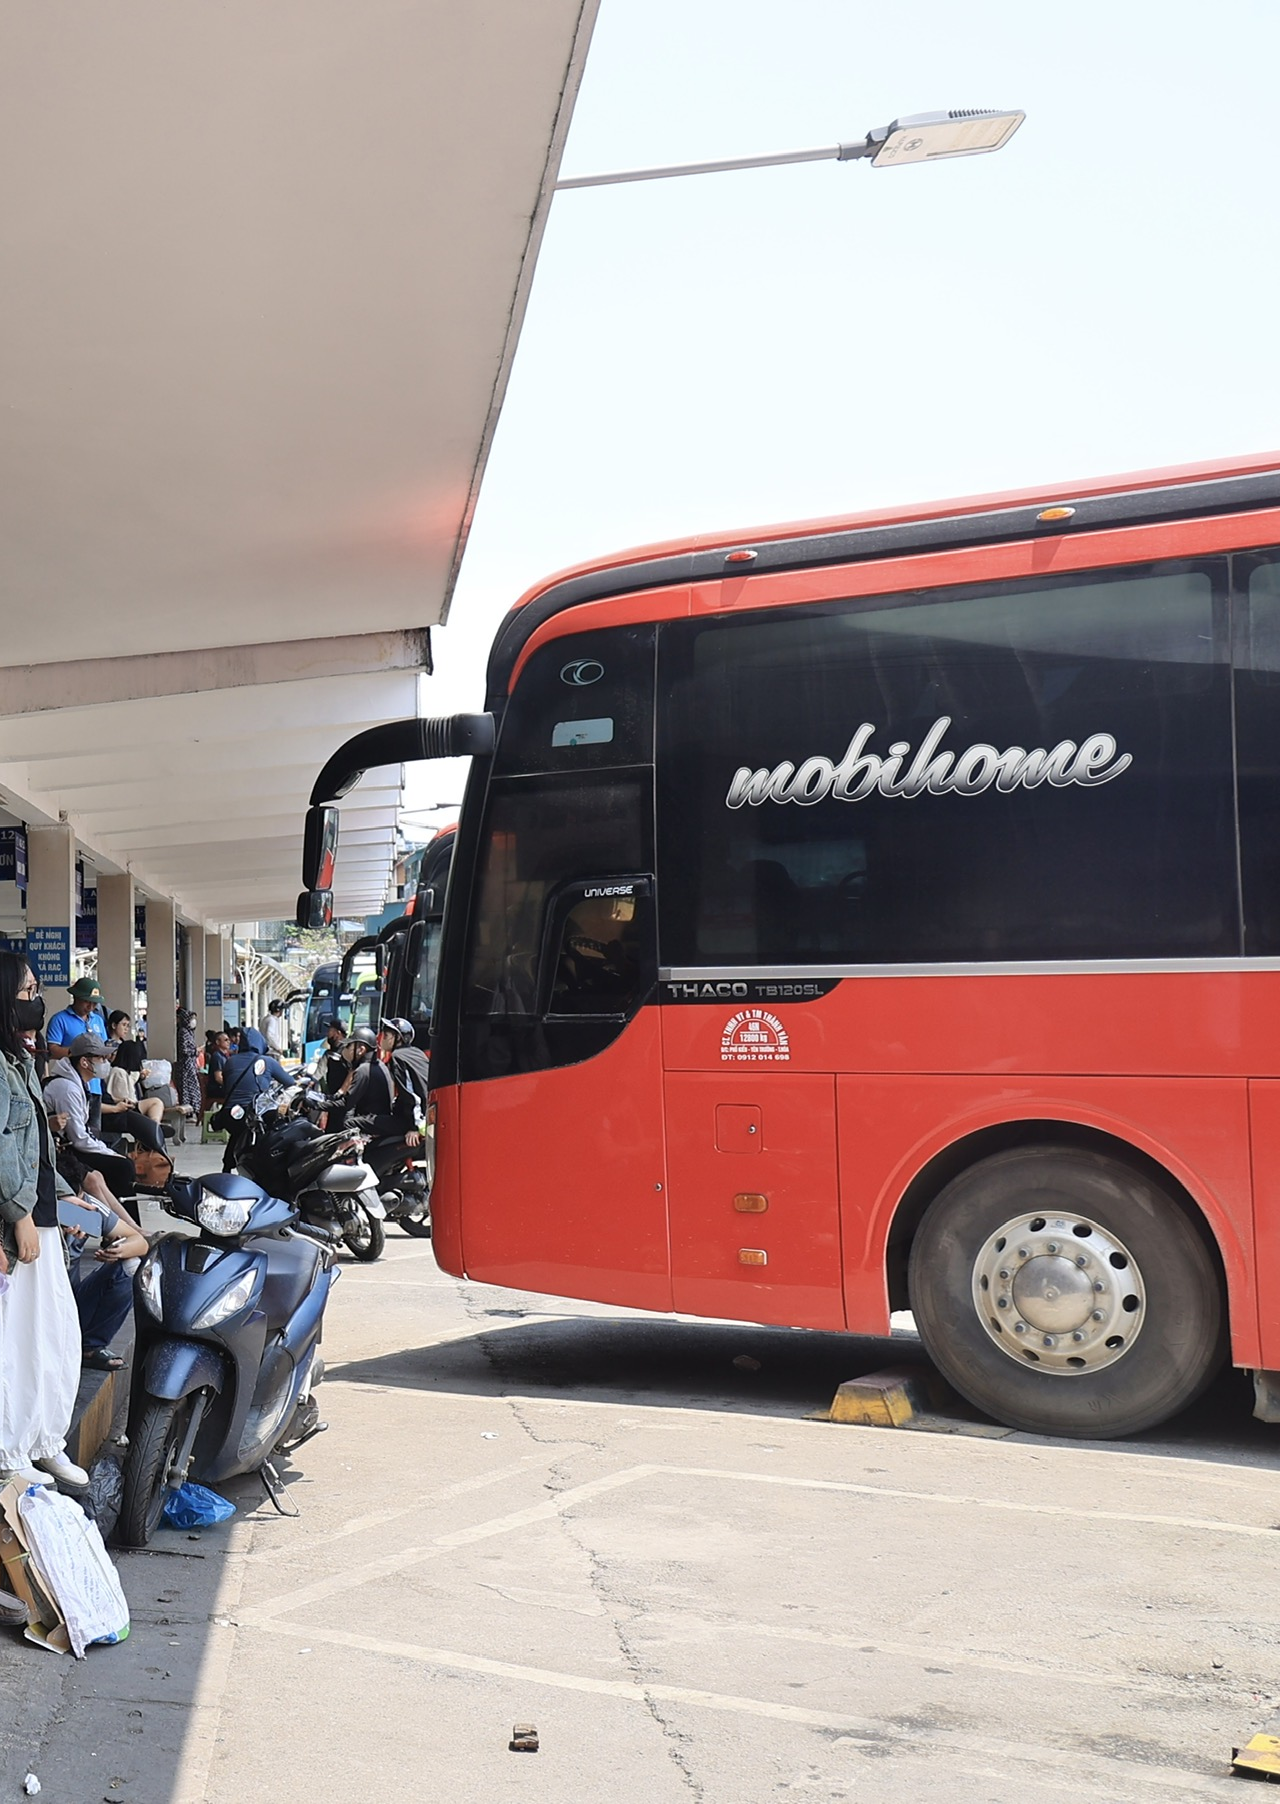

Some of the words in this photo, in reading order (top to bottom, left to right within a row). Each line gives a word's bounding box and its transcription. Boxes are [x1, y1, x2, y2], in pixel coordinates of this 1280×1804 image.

[726, 716, 1133, 809] mobihome
[584, 885, 634, 898] UNIVERSE
[667, 983, 748, 998] THACO
[755, 984, 824, 997] TB120SL
